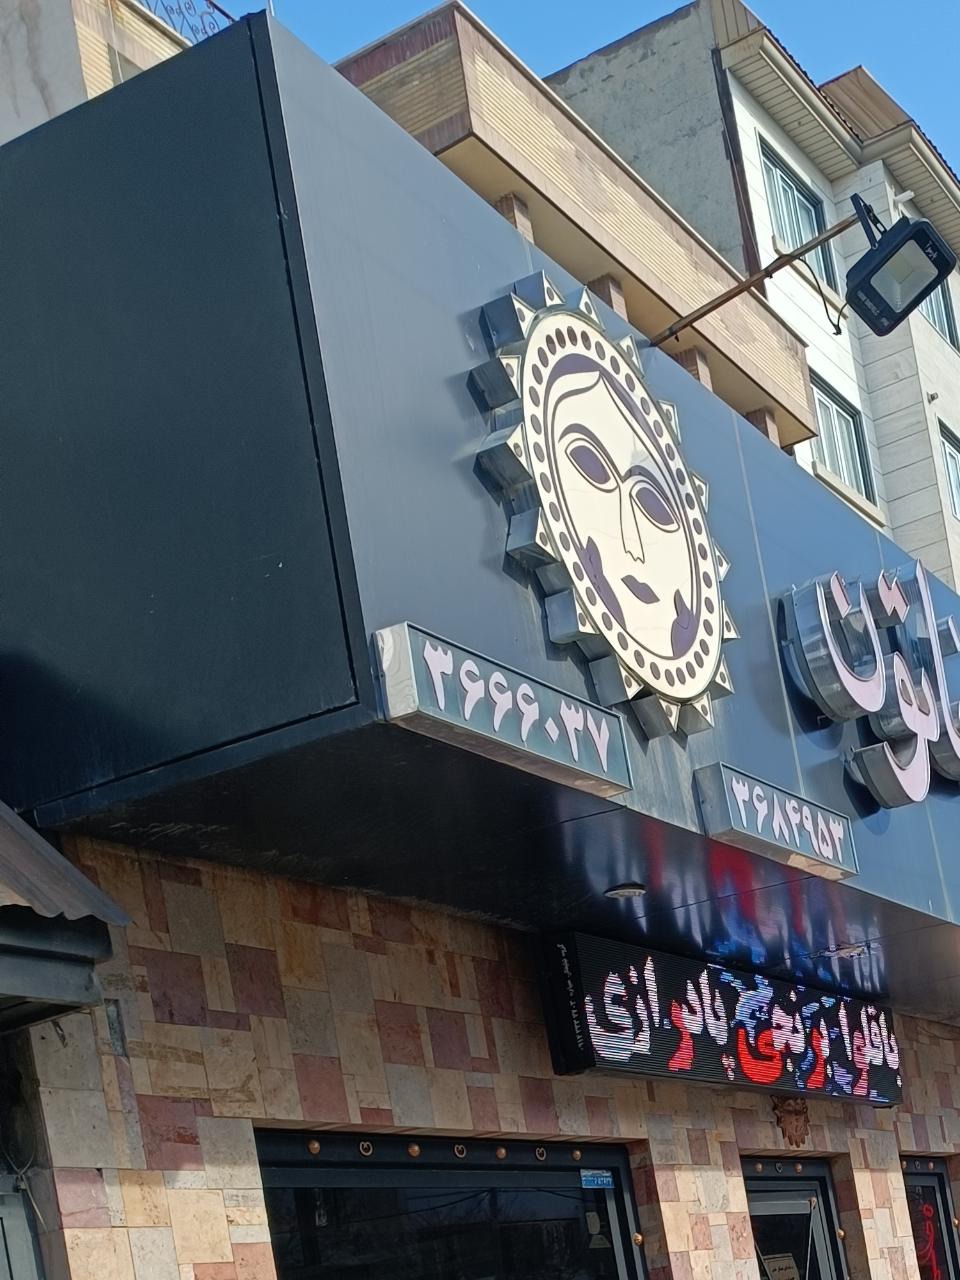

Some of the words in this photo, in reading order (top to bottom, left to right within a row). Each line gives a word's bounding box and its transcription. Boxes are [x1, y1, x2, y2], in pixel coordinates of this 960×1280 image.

[423, 639, 610, 772] ۳۶۶۶۰۳۷
[731, 775, 844, 863] ۳۶۸۴۹۵۳
[837, 1001, 902, 1097] باقلوا
